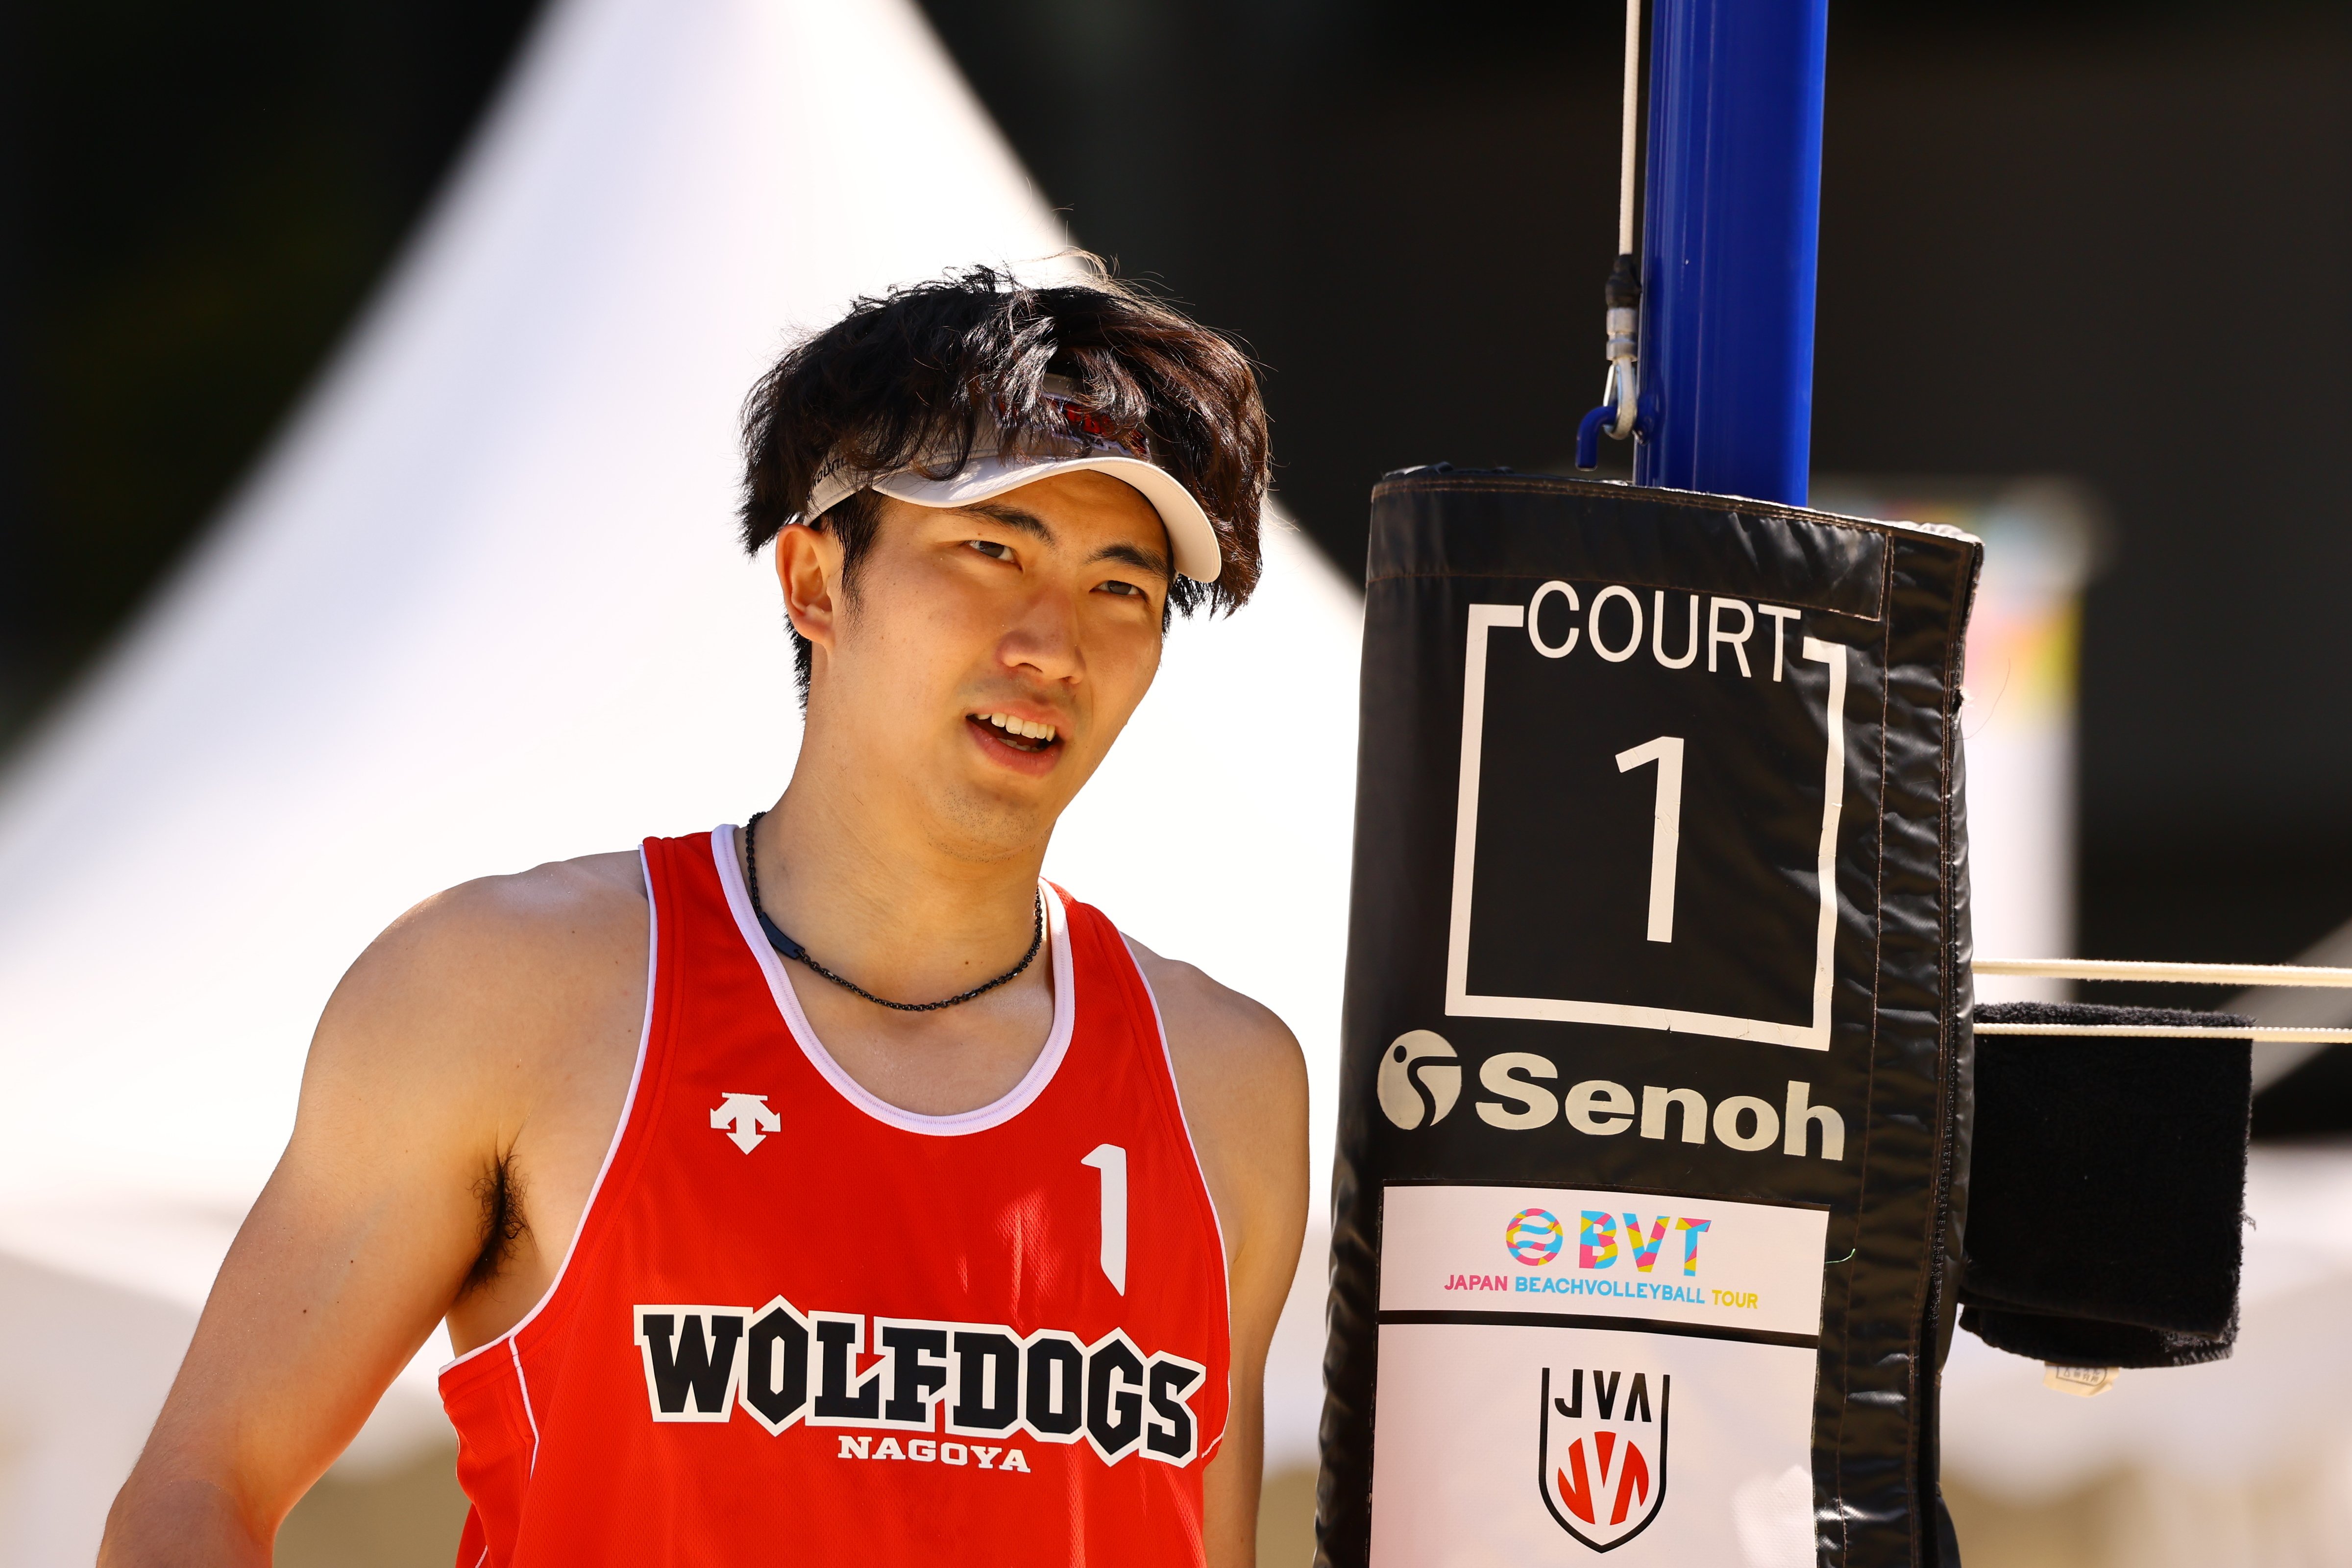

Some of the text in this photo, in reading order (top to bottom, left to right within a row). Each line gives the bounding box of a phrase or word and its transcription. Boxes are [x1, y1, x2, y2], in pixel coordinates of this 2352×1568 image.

[1528, 581, 1801, 682] COURT
[1616, 736, 1684, 943] 1
[1475, 1052, 1844, 1161] Senoh
[1081, 1144, 1127, 1296] 1
[1579, 1210, 1711, 1276] BVT
[1444, 1274, 1758, 1309] JAPAN BEACHVOLLEYBALL TOUR
[641, 1305, 1201, 1460] WOLFDOGS
[1555, 1370, 1651, 1422] JVA
[838, 1435, 1030, 1472] NAGOYA
